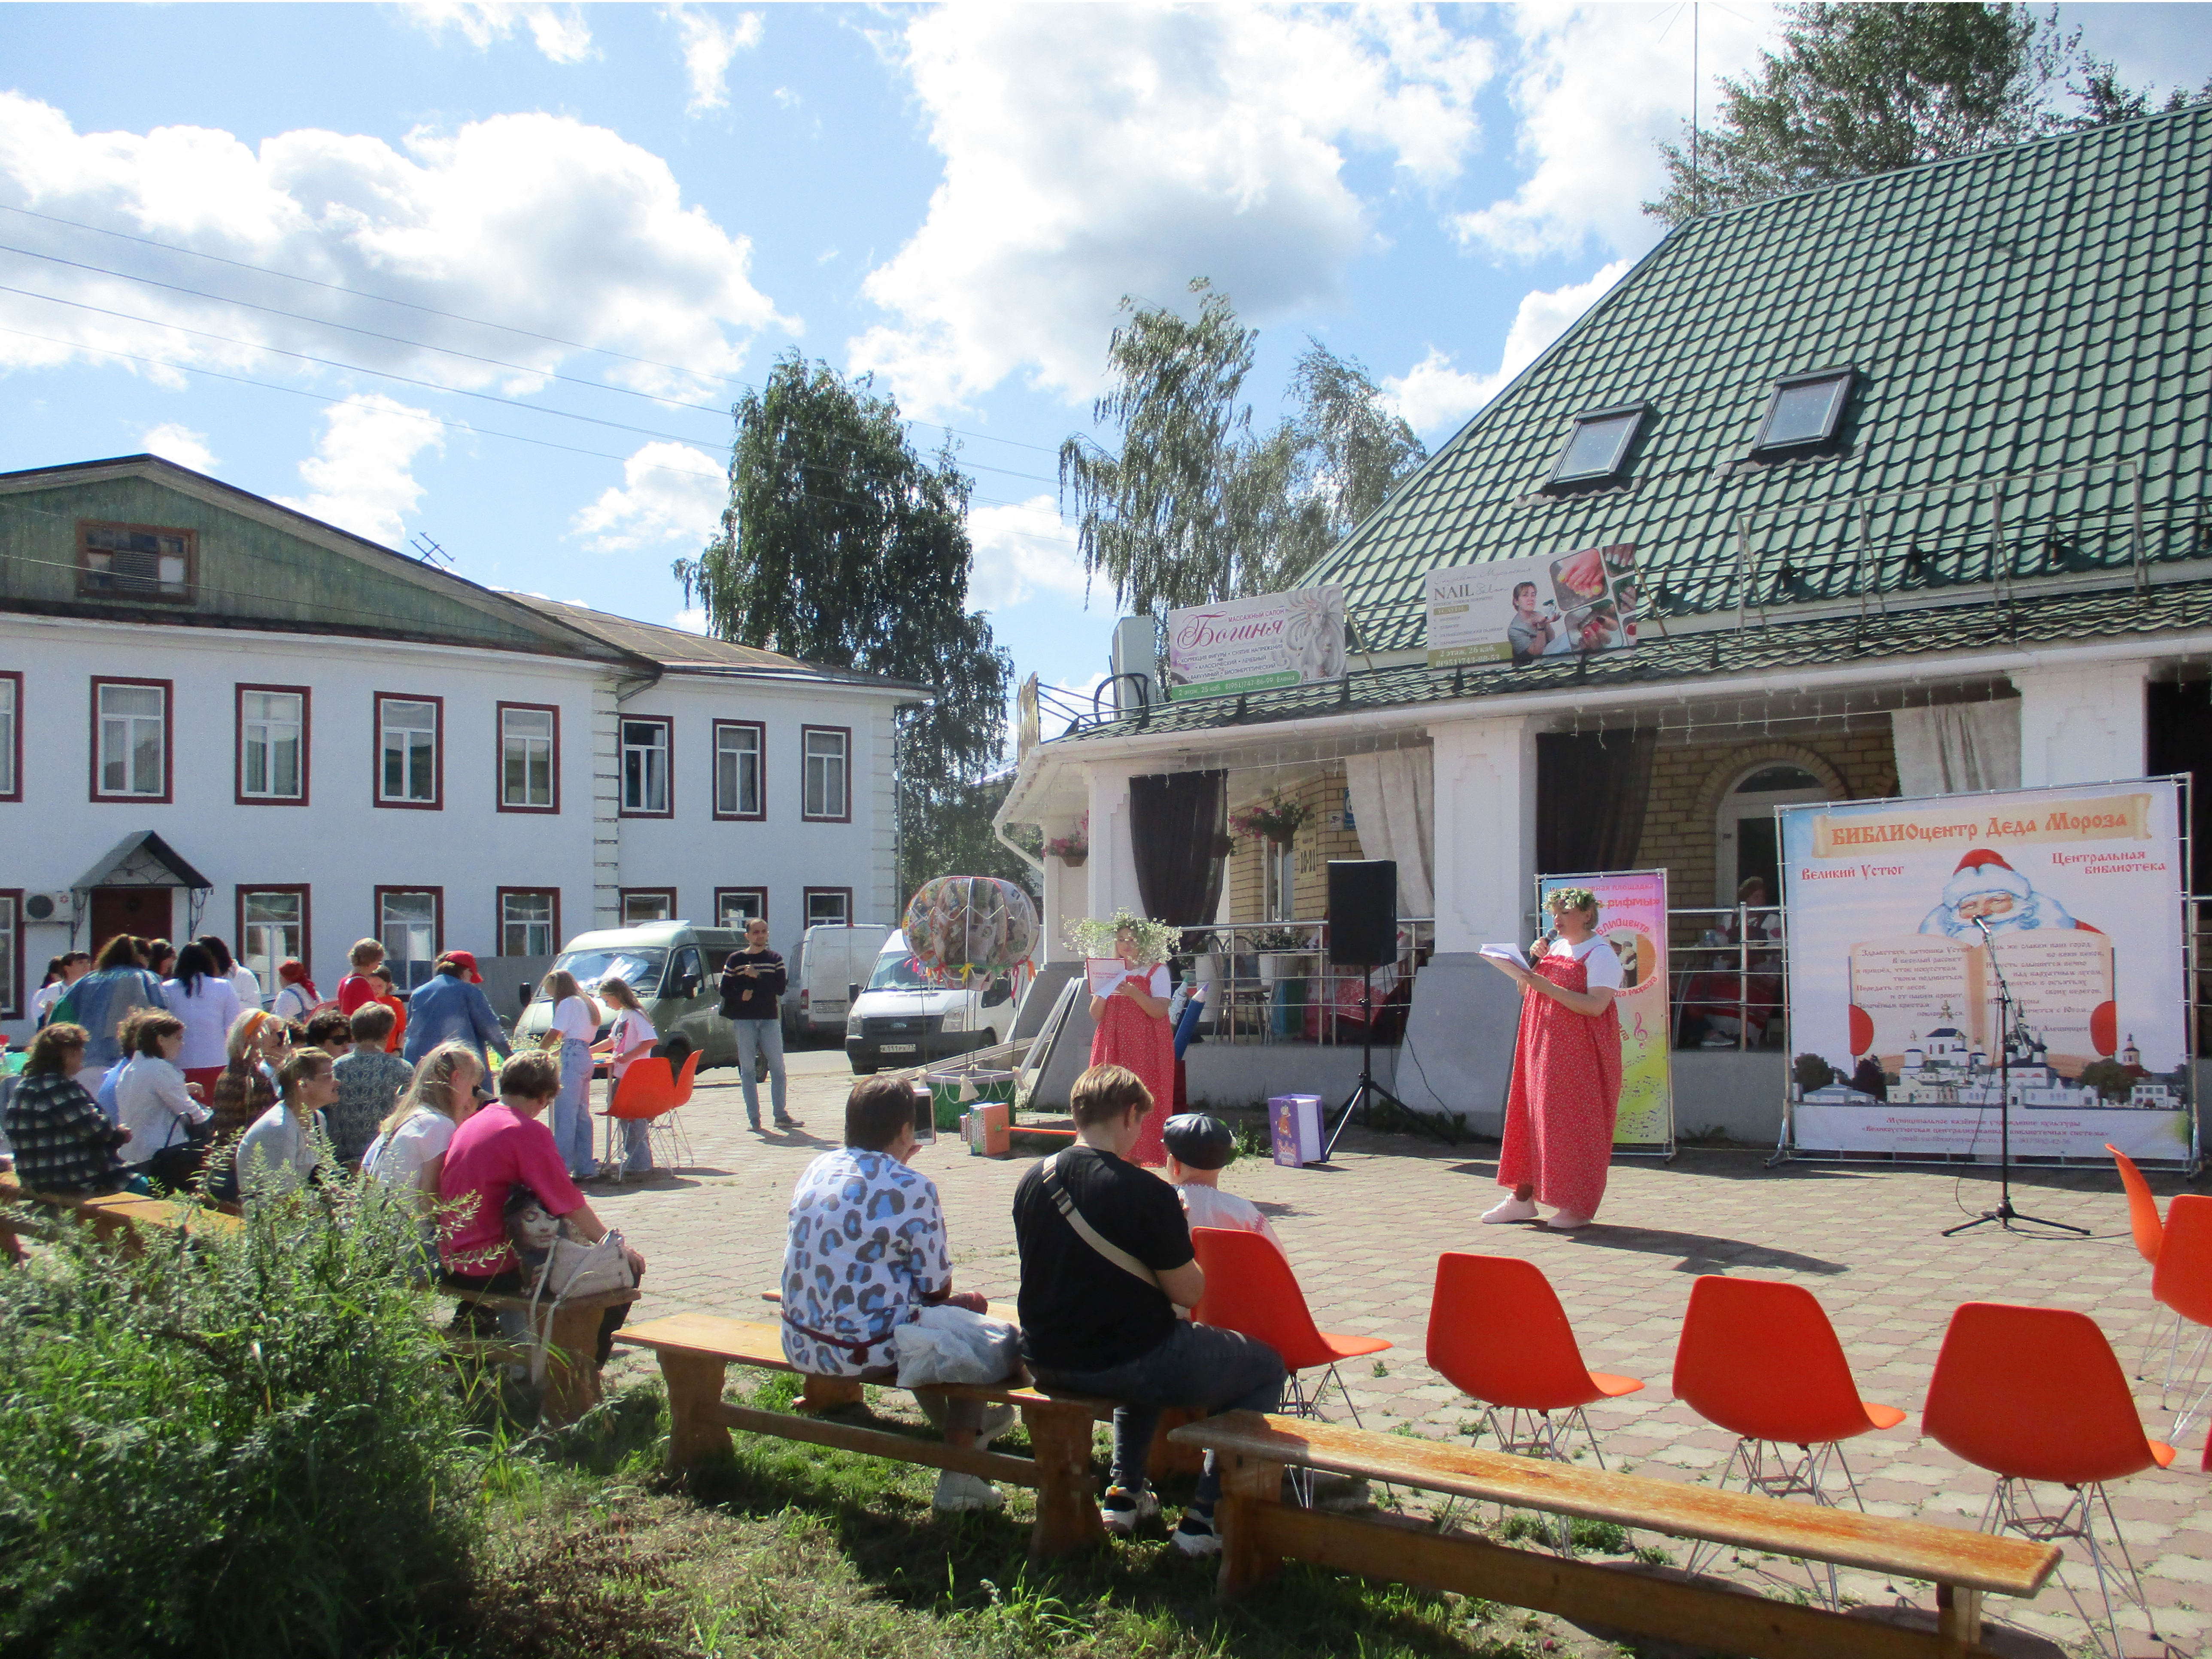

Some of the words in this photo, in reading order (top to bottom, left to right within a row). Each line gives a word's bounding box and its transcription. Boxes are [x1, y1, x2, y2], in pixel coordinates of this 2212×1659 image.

[1434, 583, 1474, 601] NAIL
[1228, 611, 1264, 623] МАССАЖНЫЙ
[1265, 608, 1285, 617] САЛОН
[1177, 610, 1286, 650] Богиня
[1181, 655, 1207, 664] КОРРЕКЦИЯ
[1208, 652, 1227, 660] ФИГУРЫ
[1251, 644, 1283, 653] НАПРЯЖЕНИЯ
[1198, 659, 1237, 670] КЛАССИЧЕСКИЙ
[1242, 655, 1267, 663] ЛЕЧЕБНЫЙ
[1191, 671, 1219, 680] ВАКУУМНЫЙ
[1224, 663, 1276, 675] БИОЭНЕРГЕТИЧЕСКИЙ
[1831, 823, 1978, 845] БИБЛИОцентр
[1985, 817, 2037, 838] Деда
[2045, 811, 2128, 834] Мороза
[2052, 851, 2146, 866] Центральная
[1801, 866, 1855, 881] Великий
[1860, 864, 1905, 880] Устюг
[2084, 862, 2166, 875] библиотека
[1612, 883, 1654, 891] площадка
